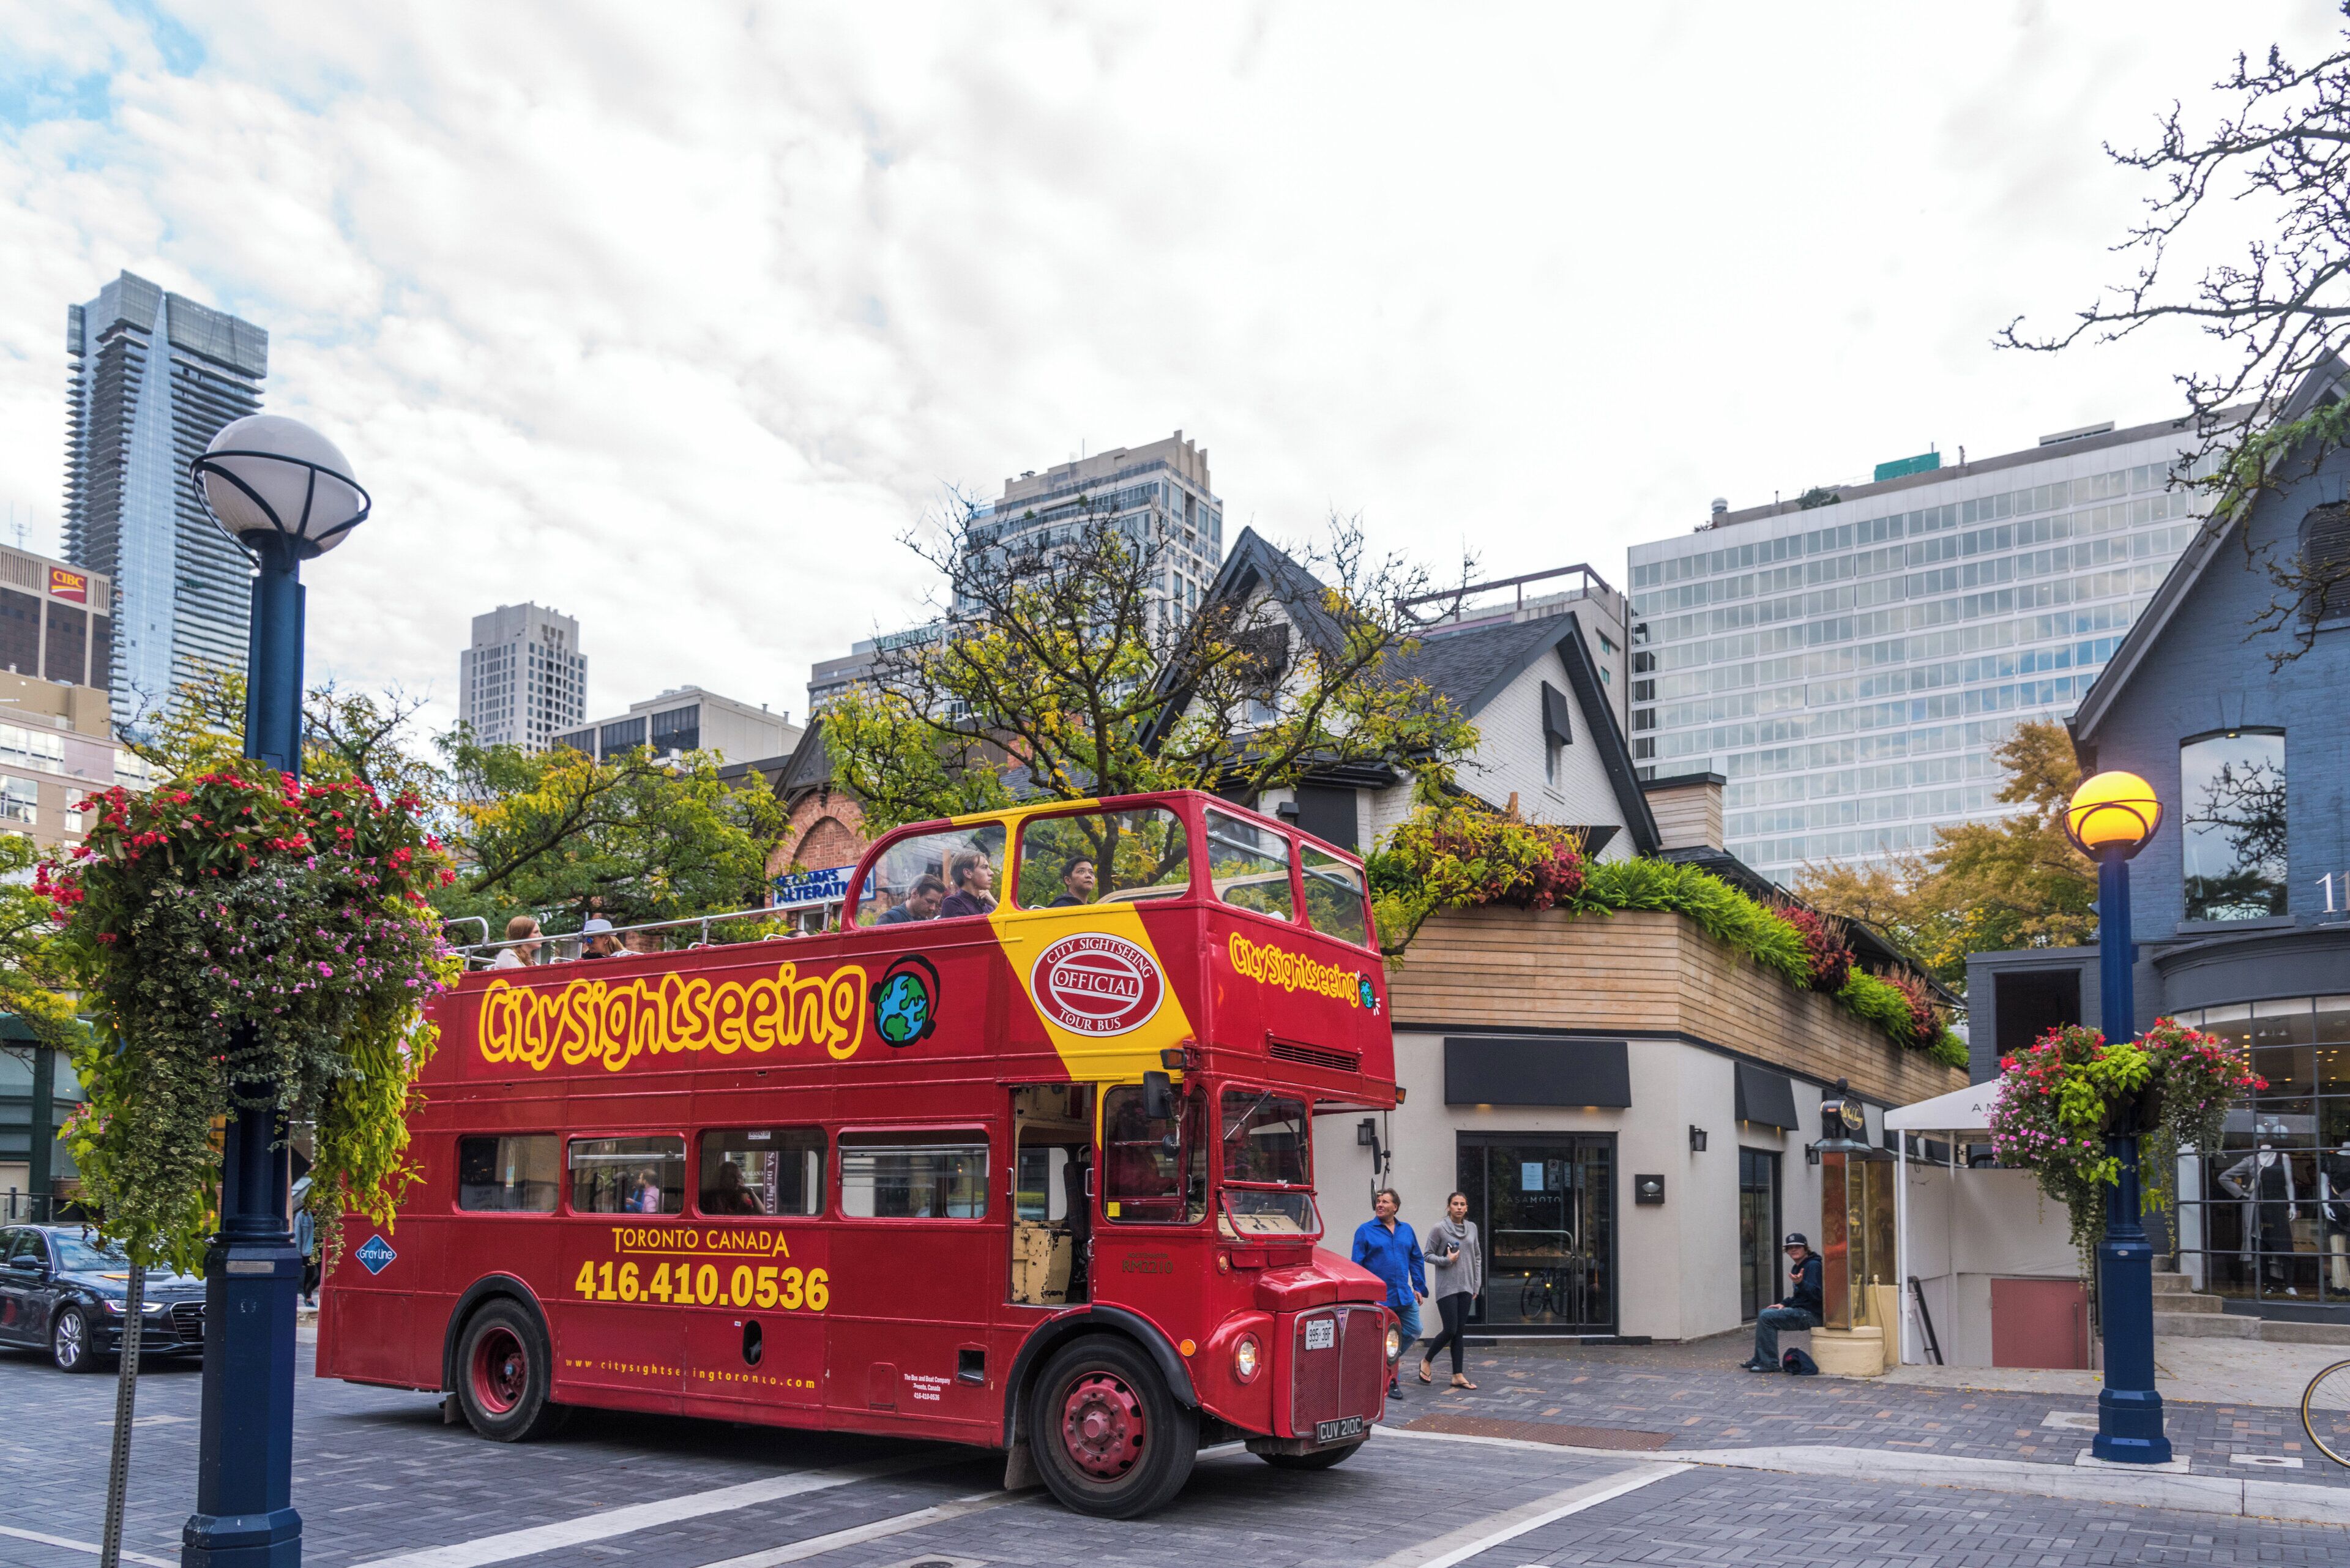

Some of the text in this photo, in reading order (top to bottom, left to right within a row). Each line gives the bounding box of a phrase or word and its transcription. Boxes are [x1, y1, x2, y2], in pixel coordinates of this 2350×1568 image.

[53, 571, 84, 588] CIBC
[777, 876, 871, 903] ALTERATIN
[1046, 938, 1154, 978] CITY SIGHTSEEING
[1054, 970, 1137, 996] OFFICIAL
[1059, 1008, 1121, 1031] TOUR BUS
[612, 1228, 790, 1258] TORONTO CANADA
[1122, 1260, 1173, 1273] RM2210
[575, 1261, 829, 1312] 416.410.0536
[934, 1376, 951, 1385] Company
[914, 1392, 940, 1401] 416-410-0536
[1321, 1418, 1361, 1439] CUV 210C
